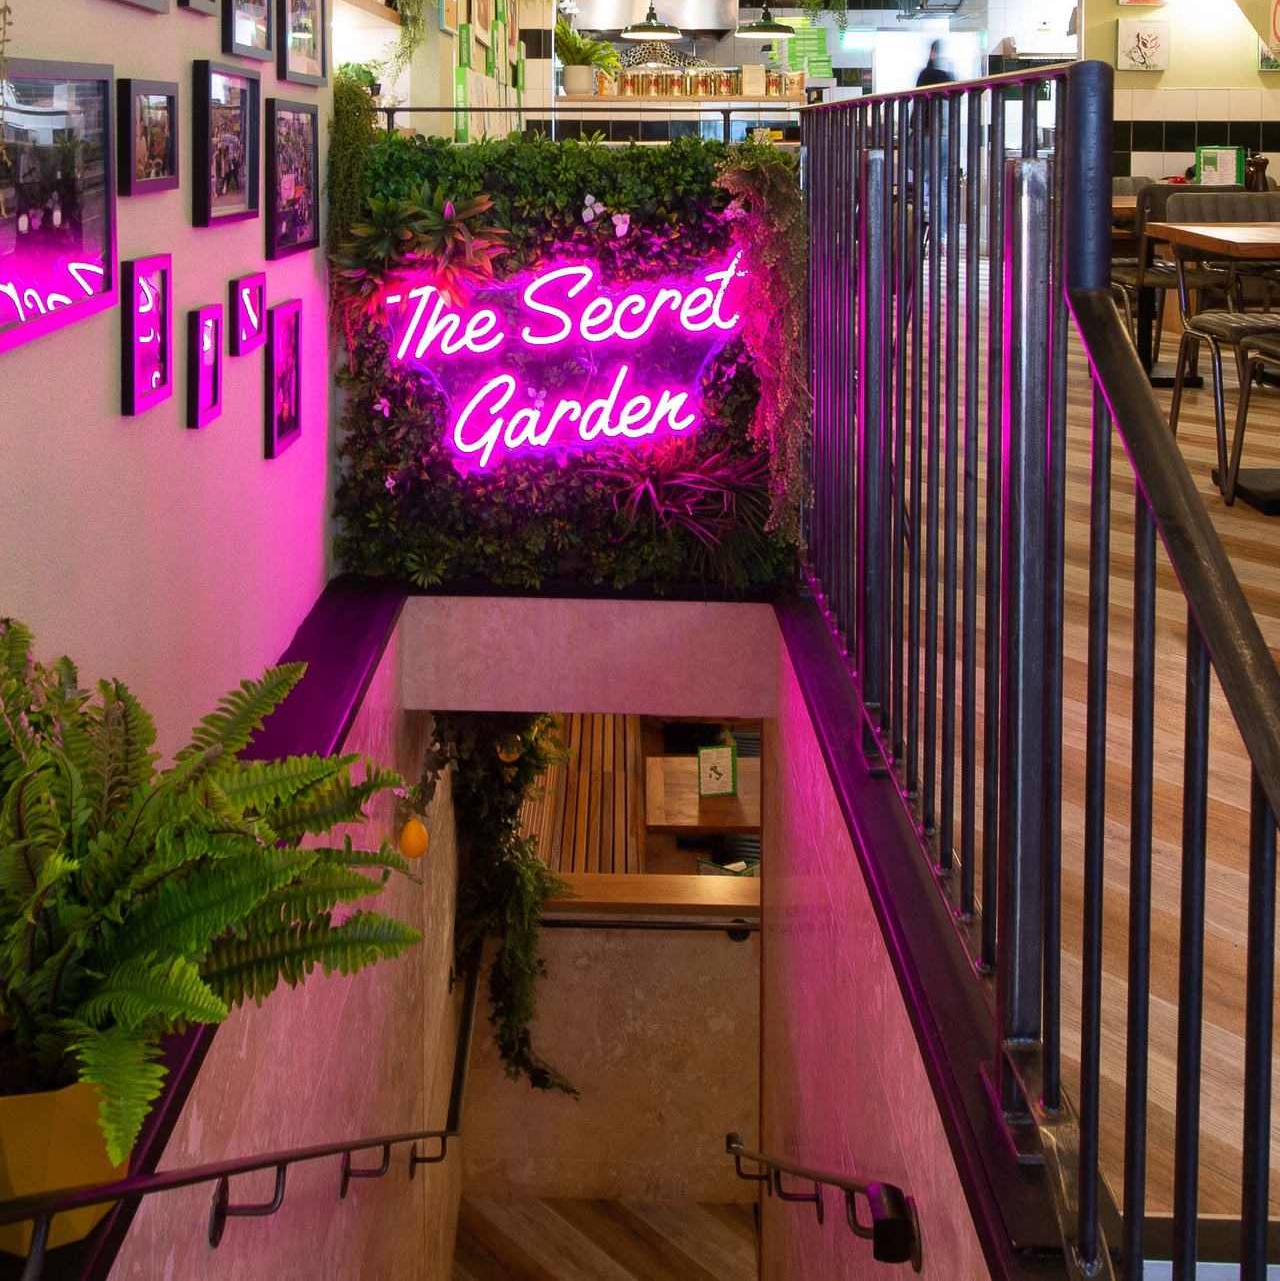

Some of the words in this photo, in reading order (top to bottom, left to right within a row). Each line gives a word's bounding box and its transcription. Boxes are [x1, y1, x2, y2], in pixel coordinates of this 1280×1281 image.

[386, 285, 505, 360] The
[522, 249, 749, 346] Secret
[453, 364, 695, 468] Garden
